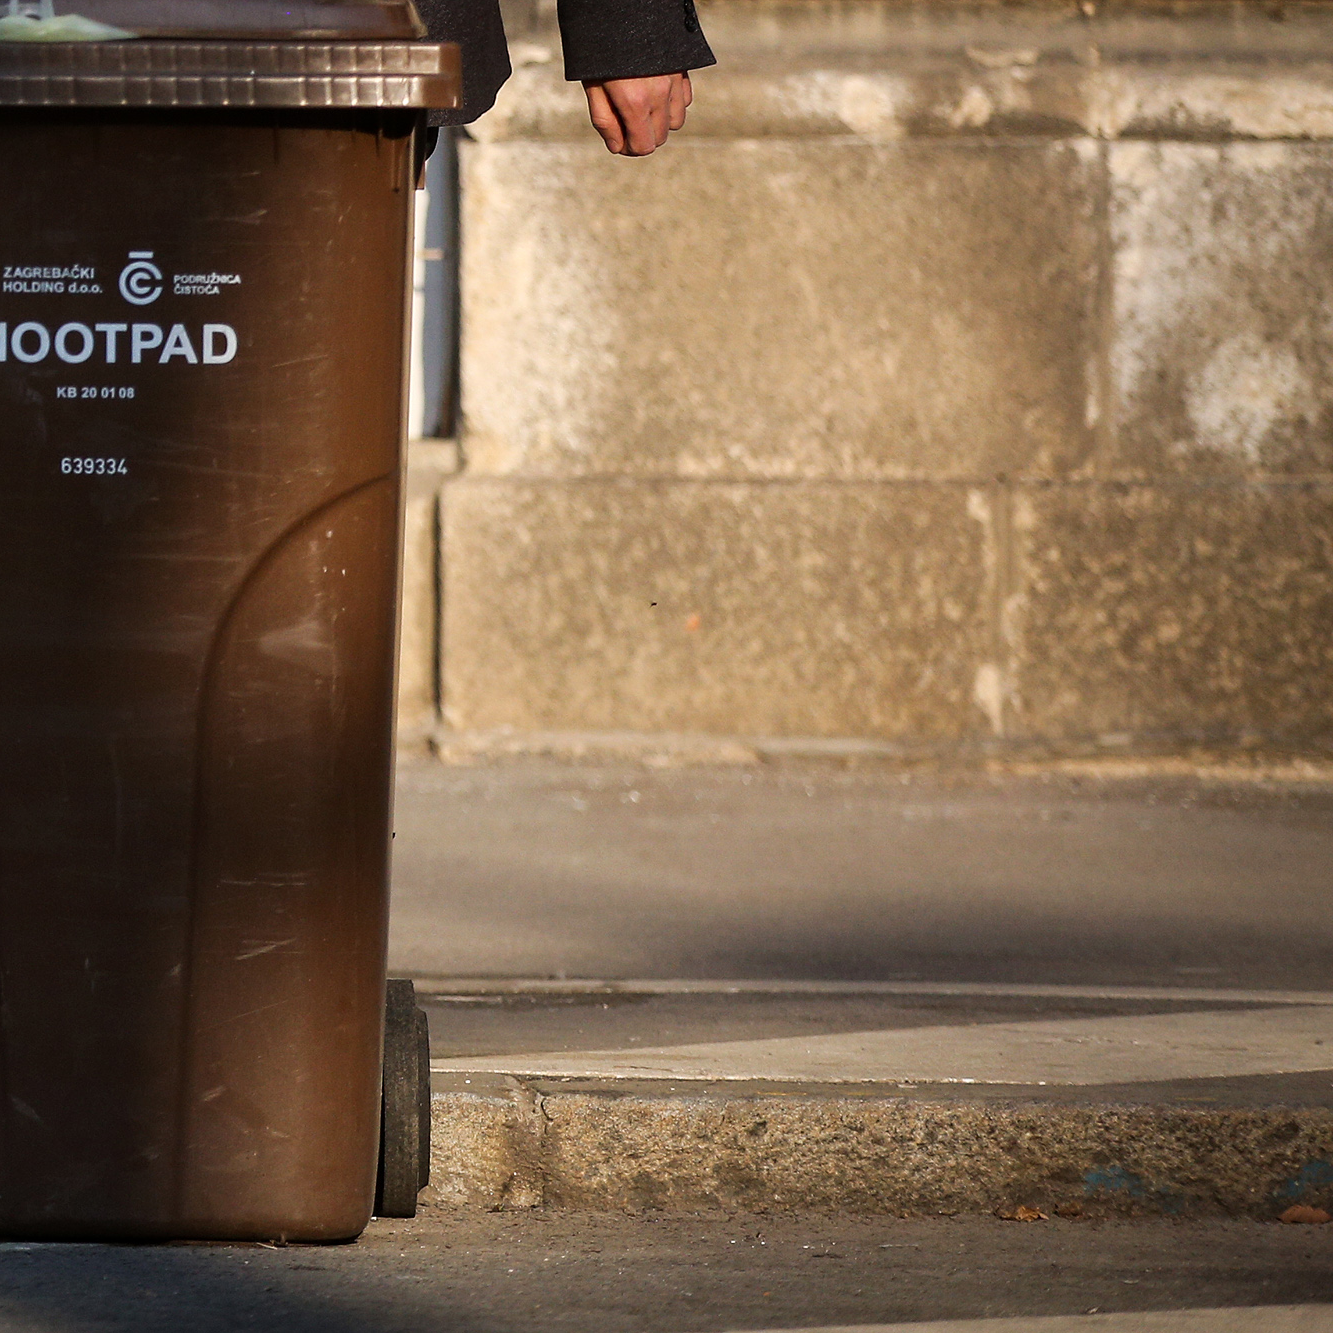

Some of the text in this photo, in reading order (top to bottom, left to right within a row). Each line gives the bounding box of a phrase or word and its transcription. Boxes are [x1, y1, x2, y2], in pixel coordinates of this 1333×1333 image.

[3, 264, 95, 279] ZAGREBAČKI
[2, 281, 103, 293] HOLDING d.o.o.
[56, 387, 135, 398] KB 20 01 08
[61, 457, 128, 475] 639334
